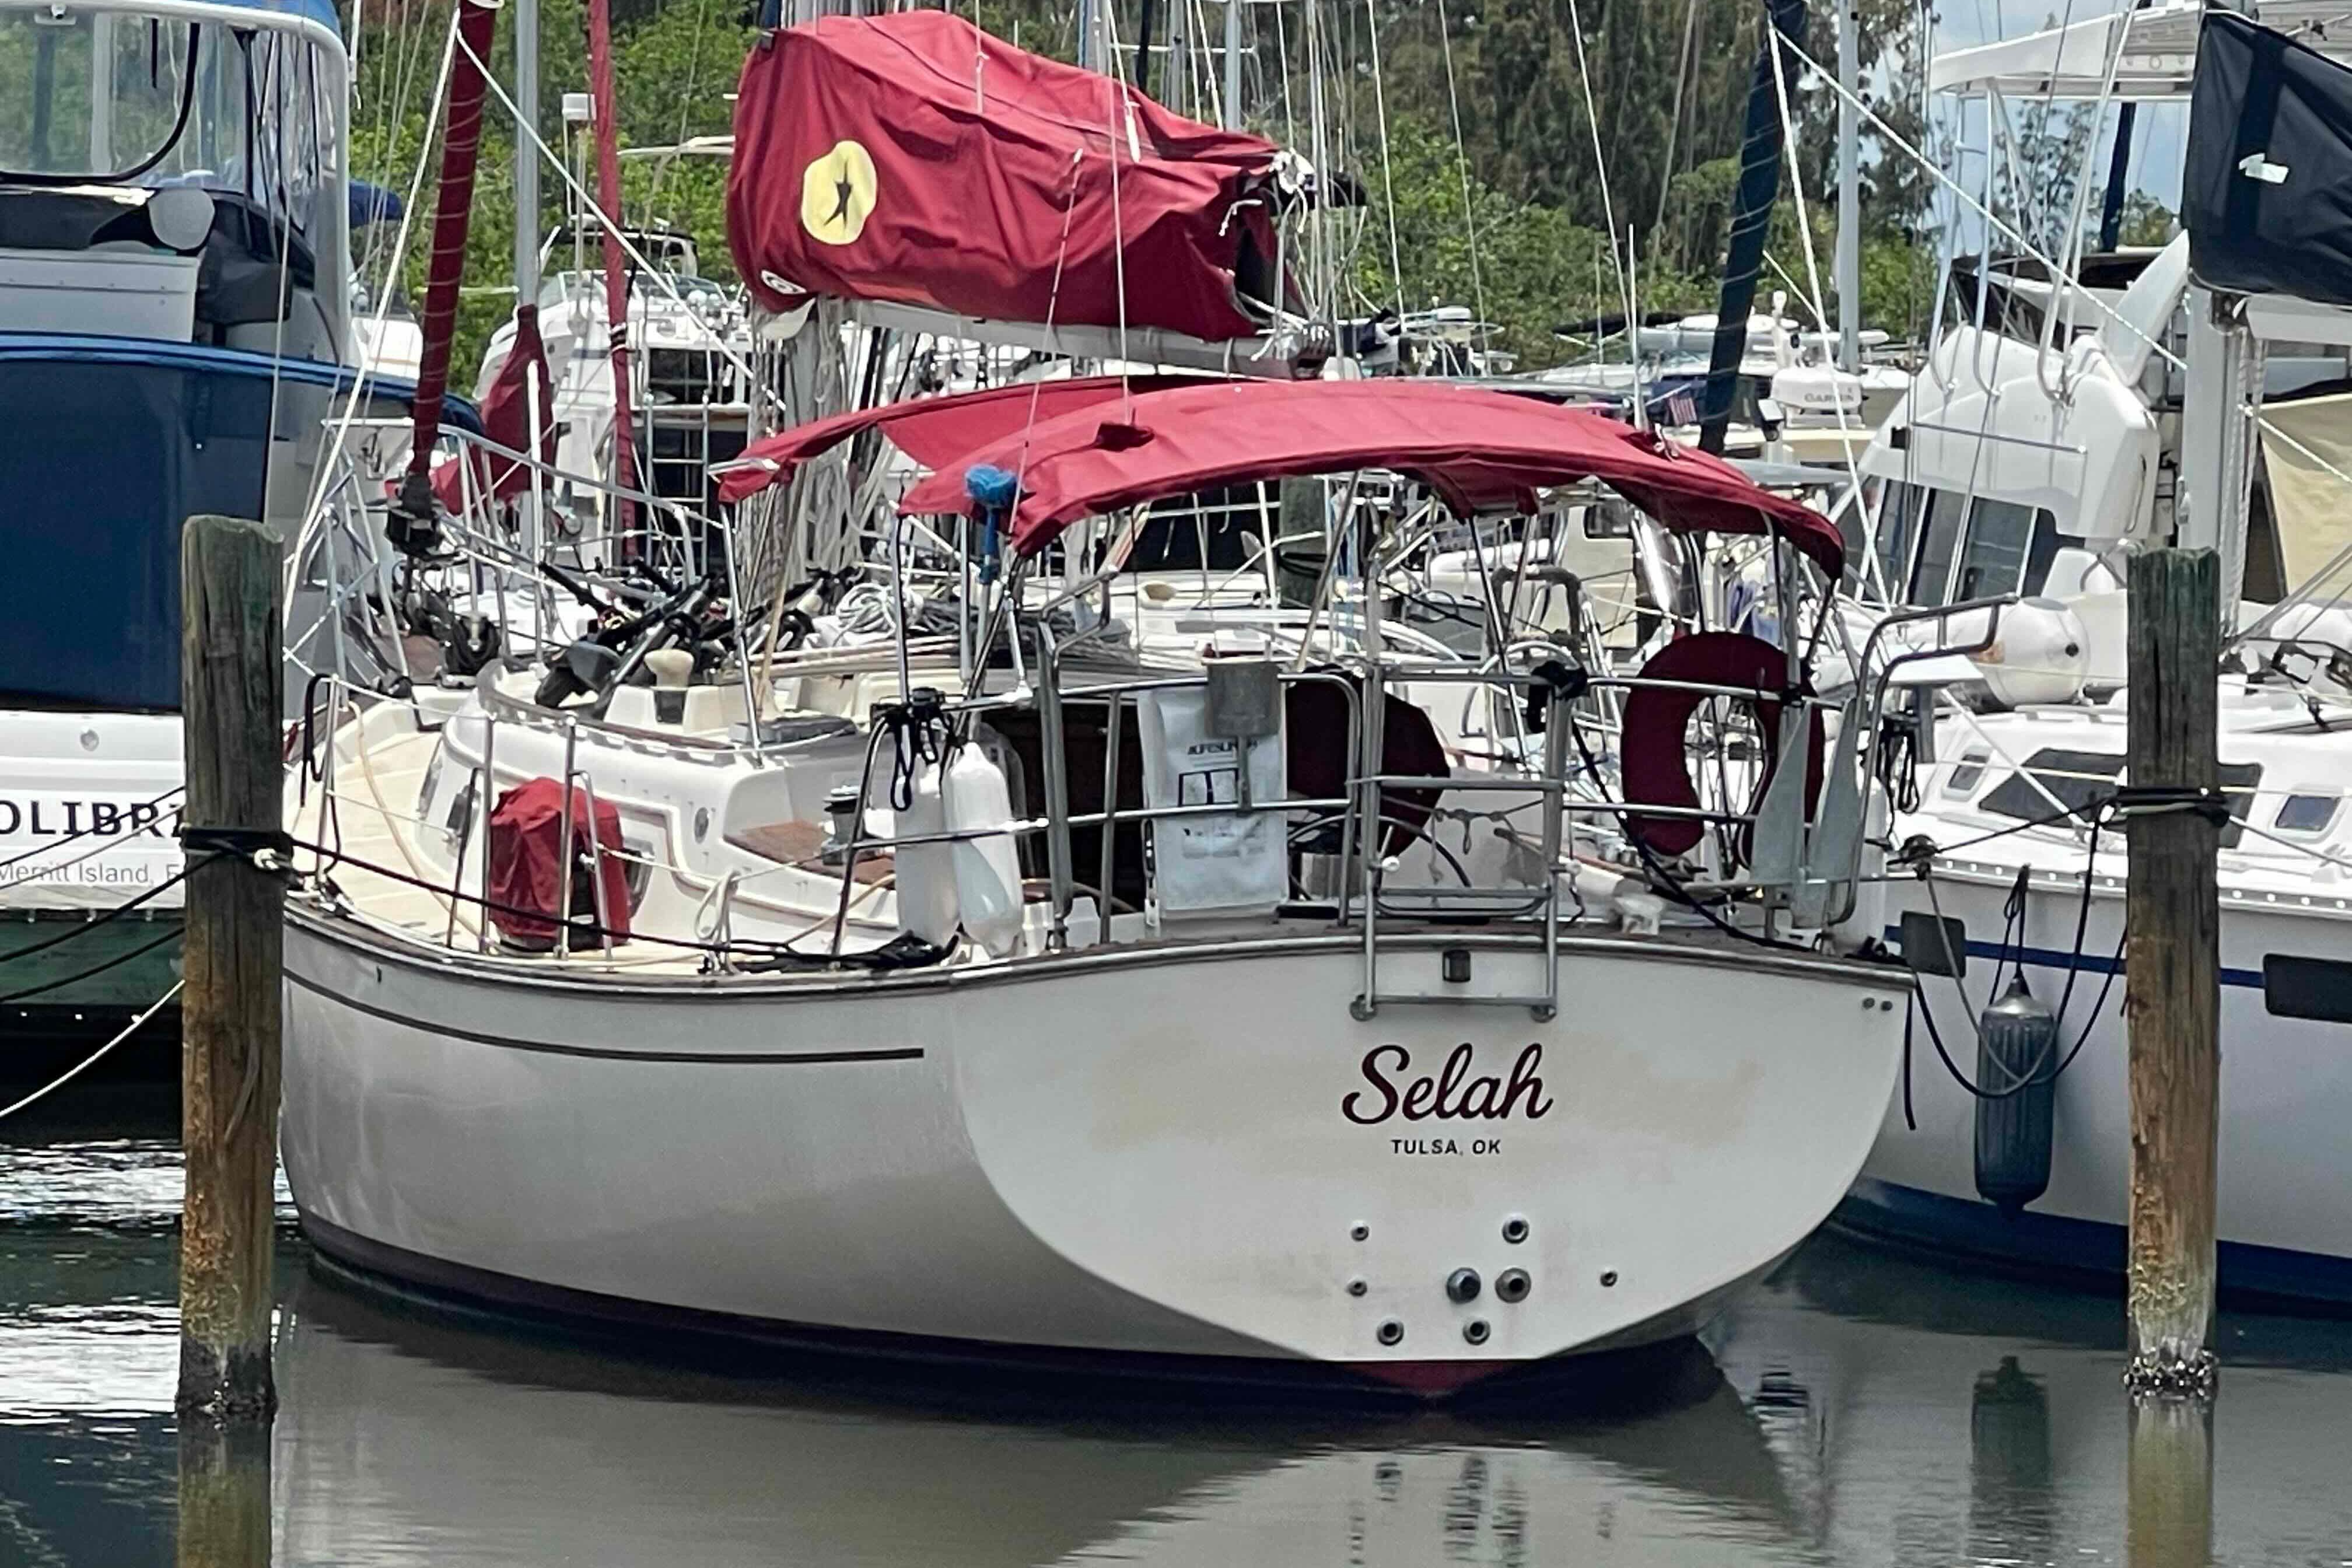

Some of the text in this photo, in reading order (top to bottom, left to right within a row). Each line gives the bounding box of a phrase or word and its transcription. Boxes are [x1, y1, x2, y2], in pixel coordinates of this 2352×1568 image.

[79, 863, 154, 884] Island,
[1342, 1043, 1553, 1124] Selah
[1391, 1139, 1501, 1156] TULSA, OK
